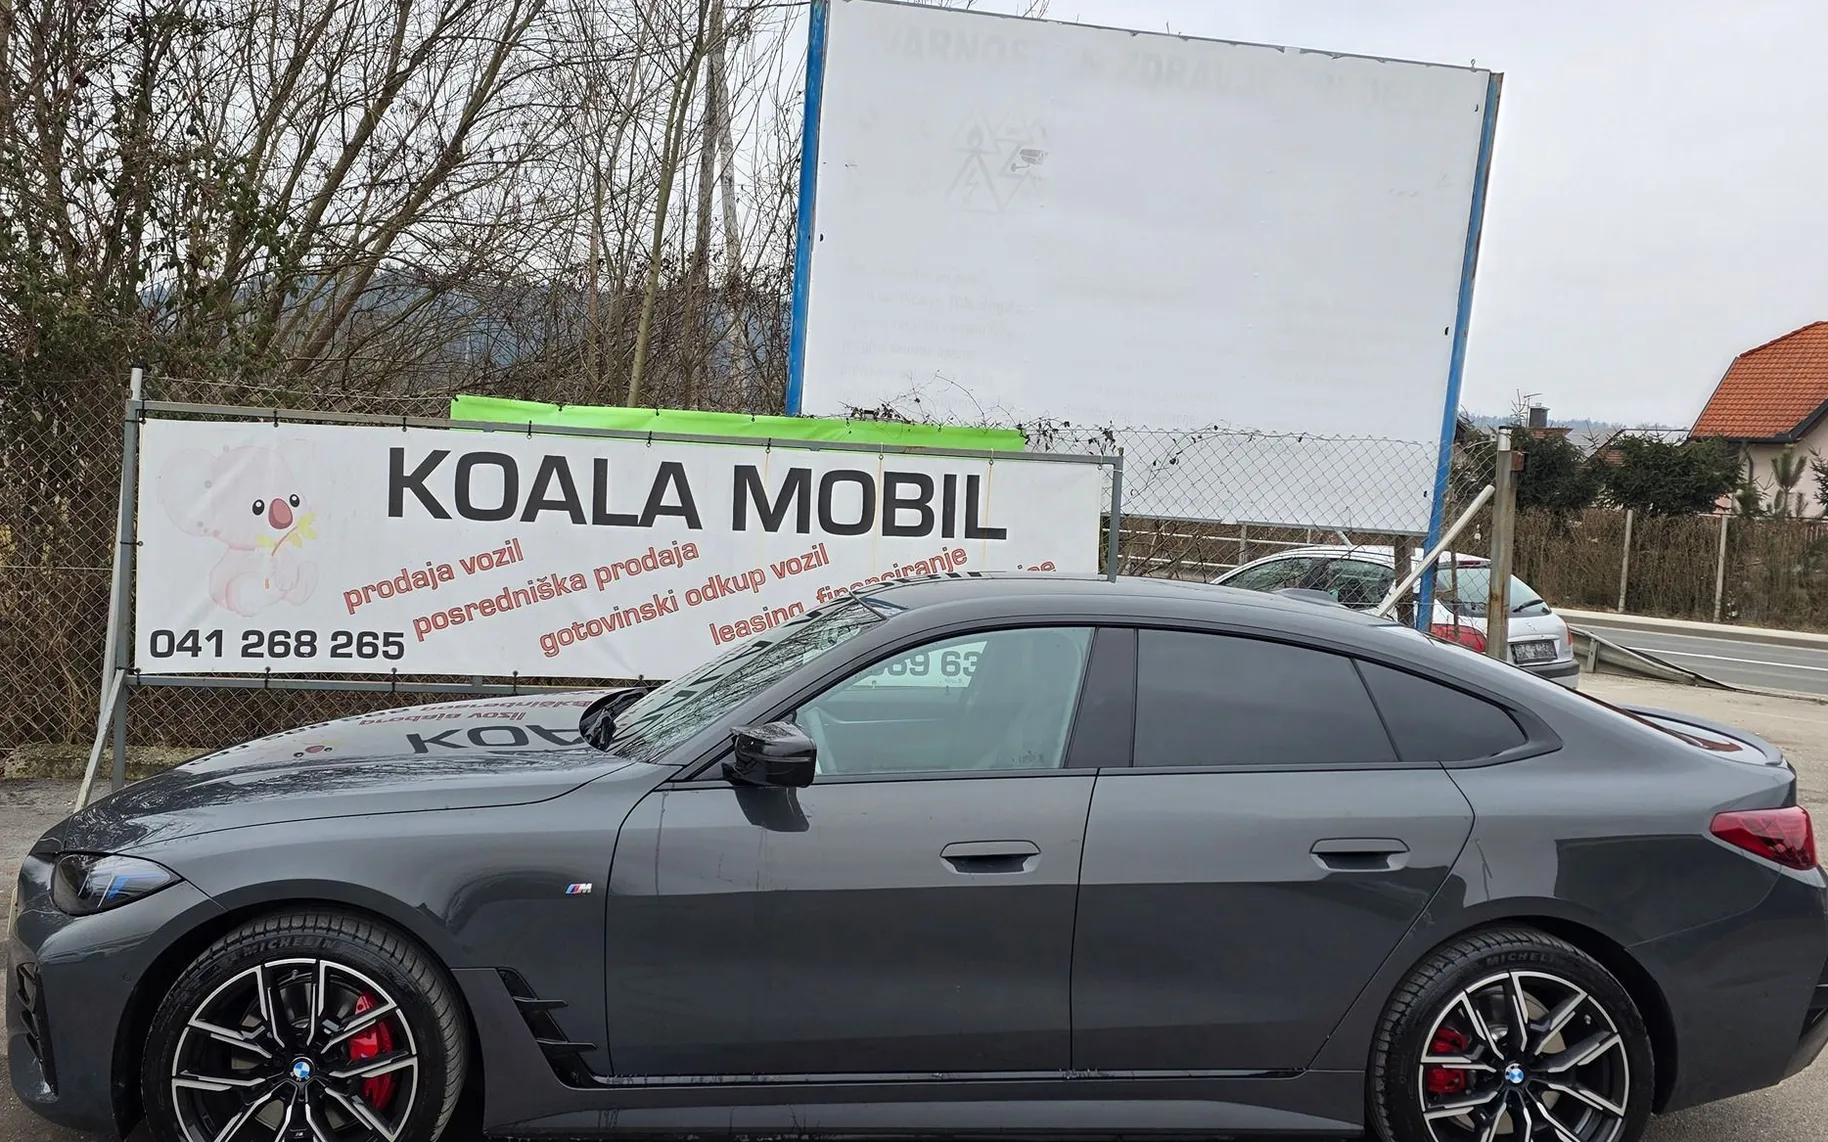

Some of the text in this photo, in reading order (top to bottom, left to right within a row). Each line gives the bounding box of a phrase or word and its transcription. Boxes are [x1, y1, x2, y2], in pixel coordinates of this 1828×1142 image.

[387, 447, 1008, 540] KOALA MOBIL
[343, 538, 524, 614] prodaja vozil
[413, 541, 700, 642] posredniška prodaja
[539, 543, 830, 658] gotovinski odkup vozil
[149, 629, 405, 661] 041 268 265
[1486, 951, 1563, 967] MICHELI
